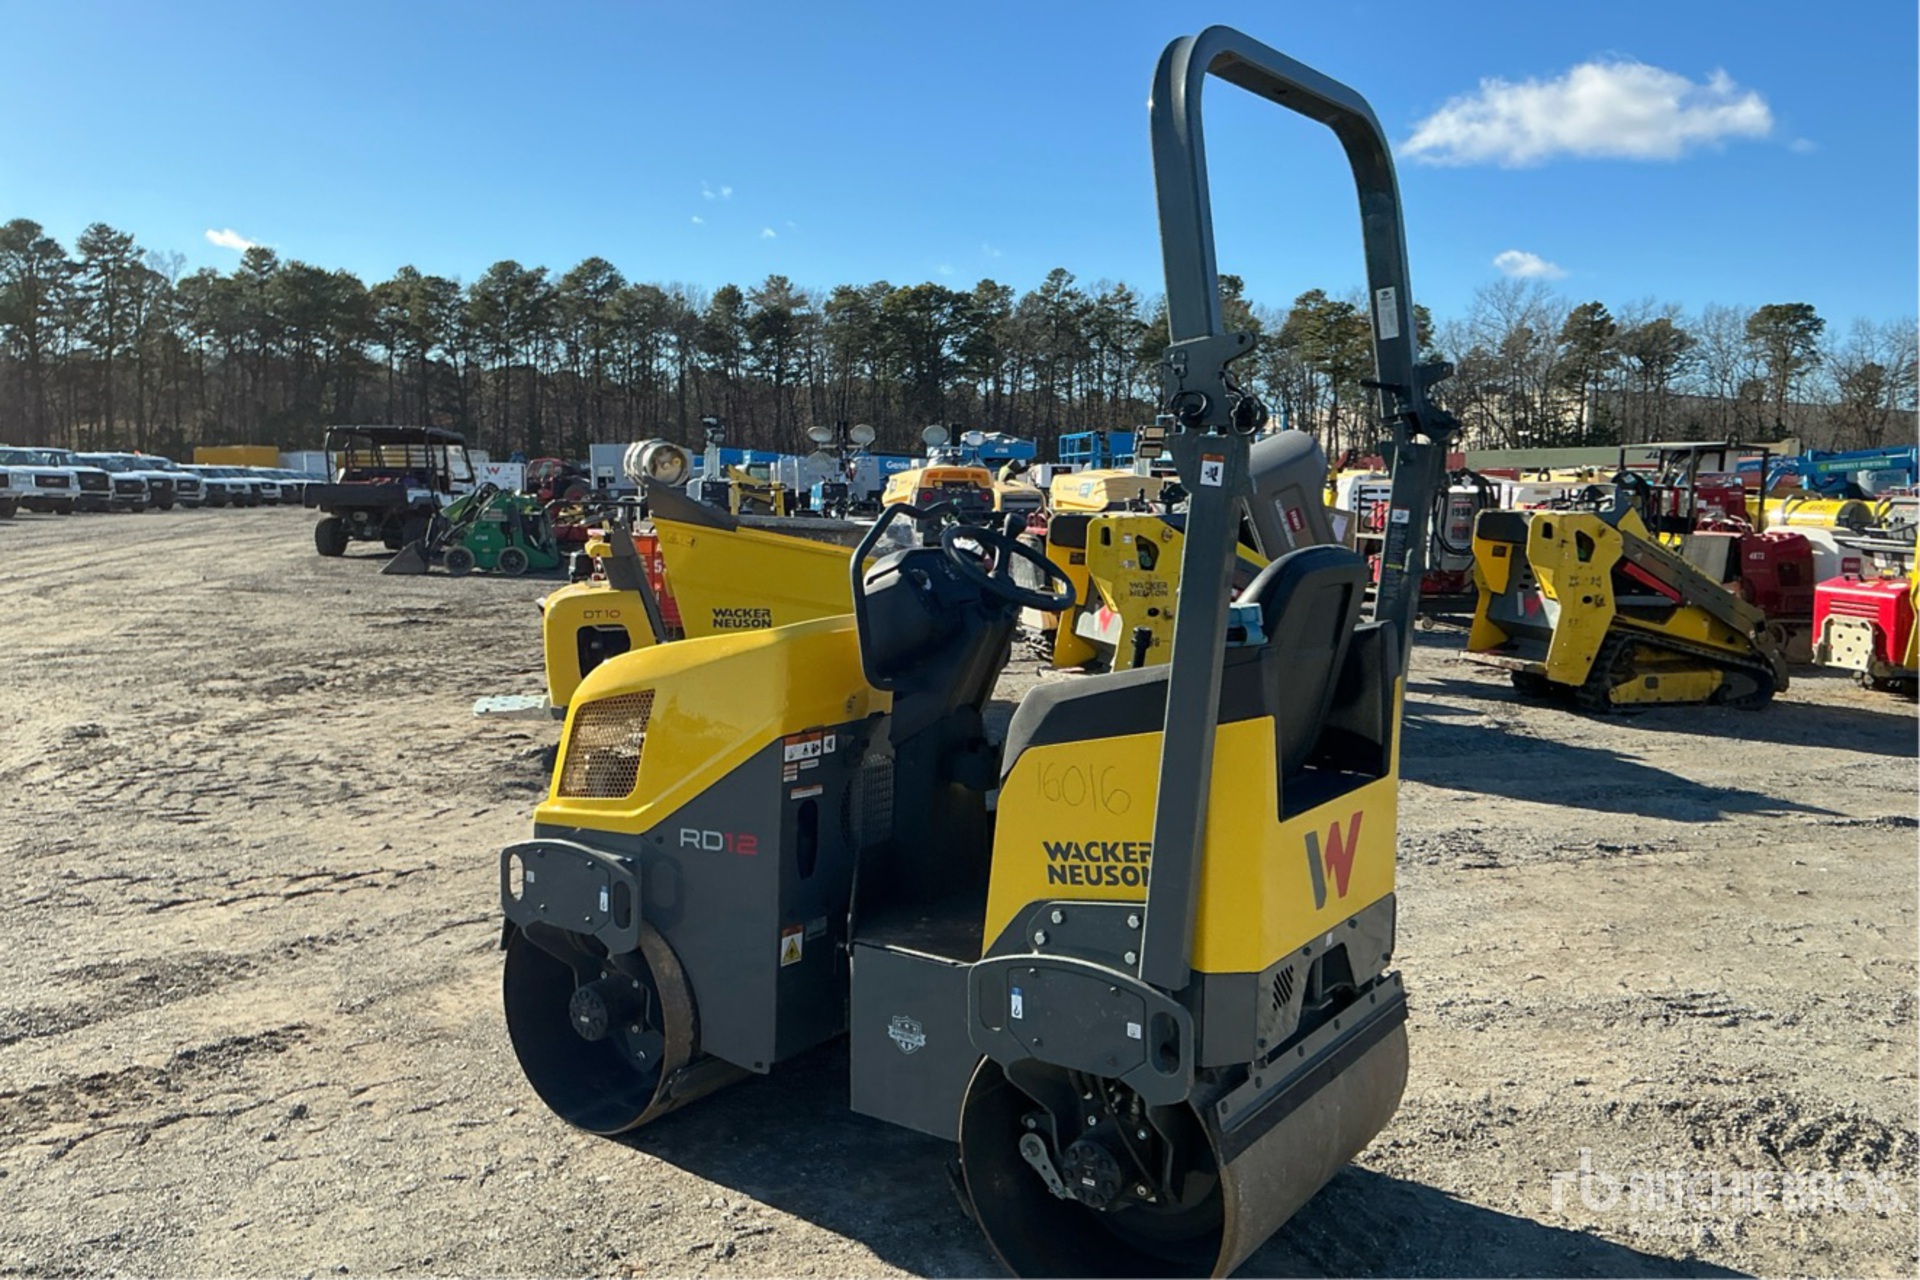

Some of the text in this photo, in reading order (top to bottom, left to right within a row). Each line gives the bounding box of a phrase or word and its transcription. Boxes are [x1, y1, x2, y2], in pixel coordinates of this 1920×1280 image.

[885, 460, 910, 470] Genie
[712, 608, 771, 619] WACKER
[712, 618, 772, 629] NEUSON
[1036, 760, 1132, 815] 16016
[679, 827, 758, 856] RD12
[1042, 841, 1153, 863] WACKER
